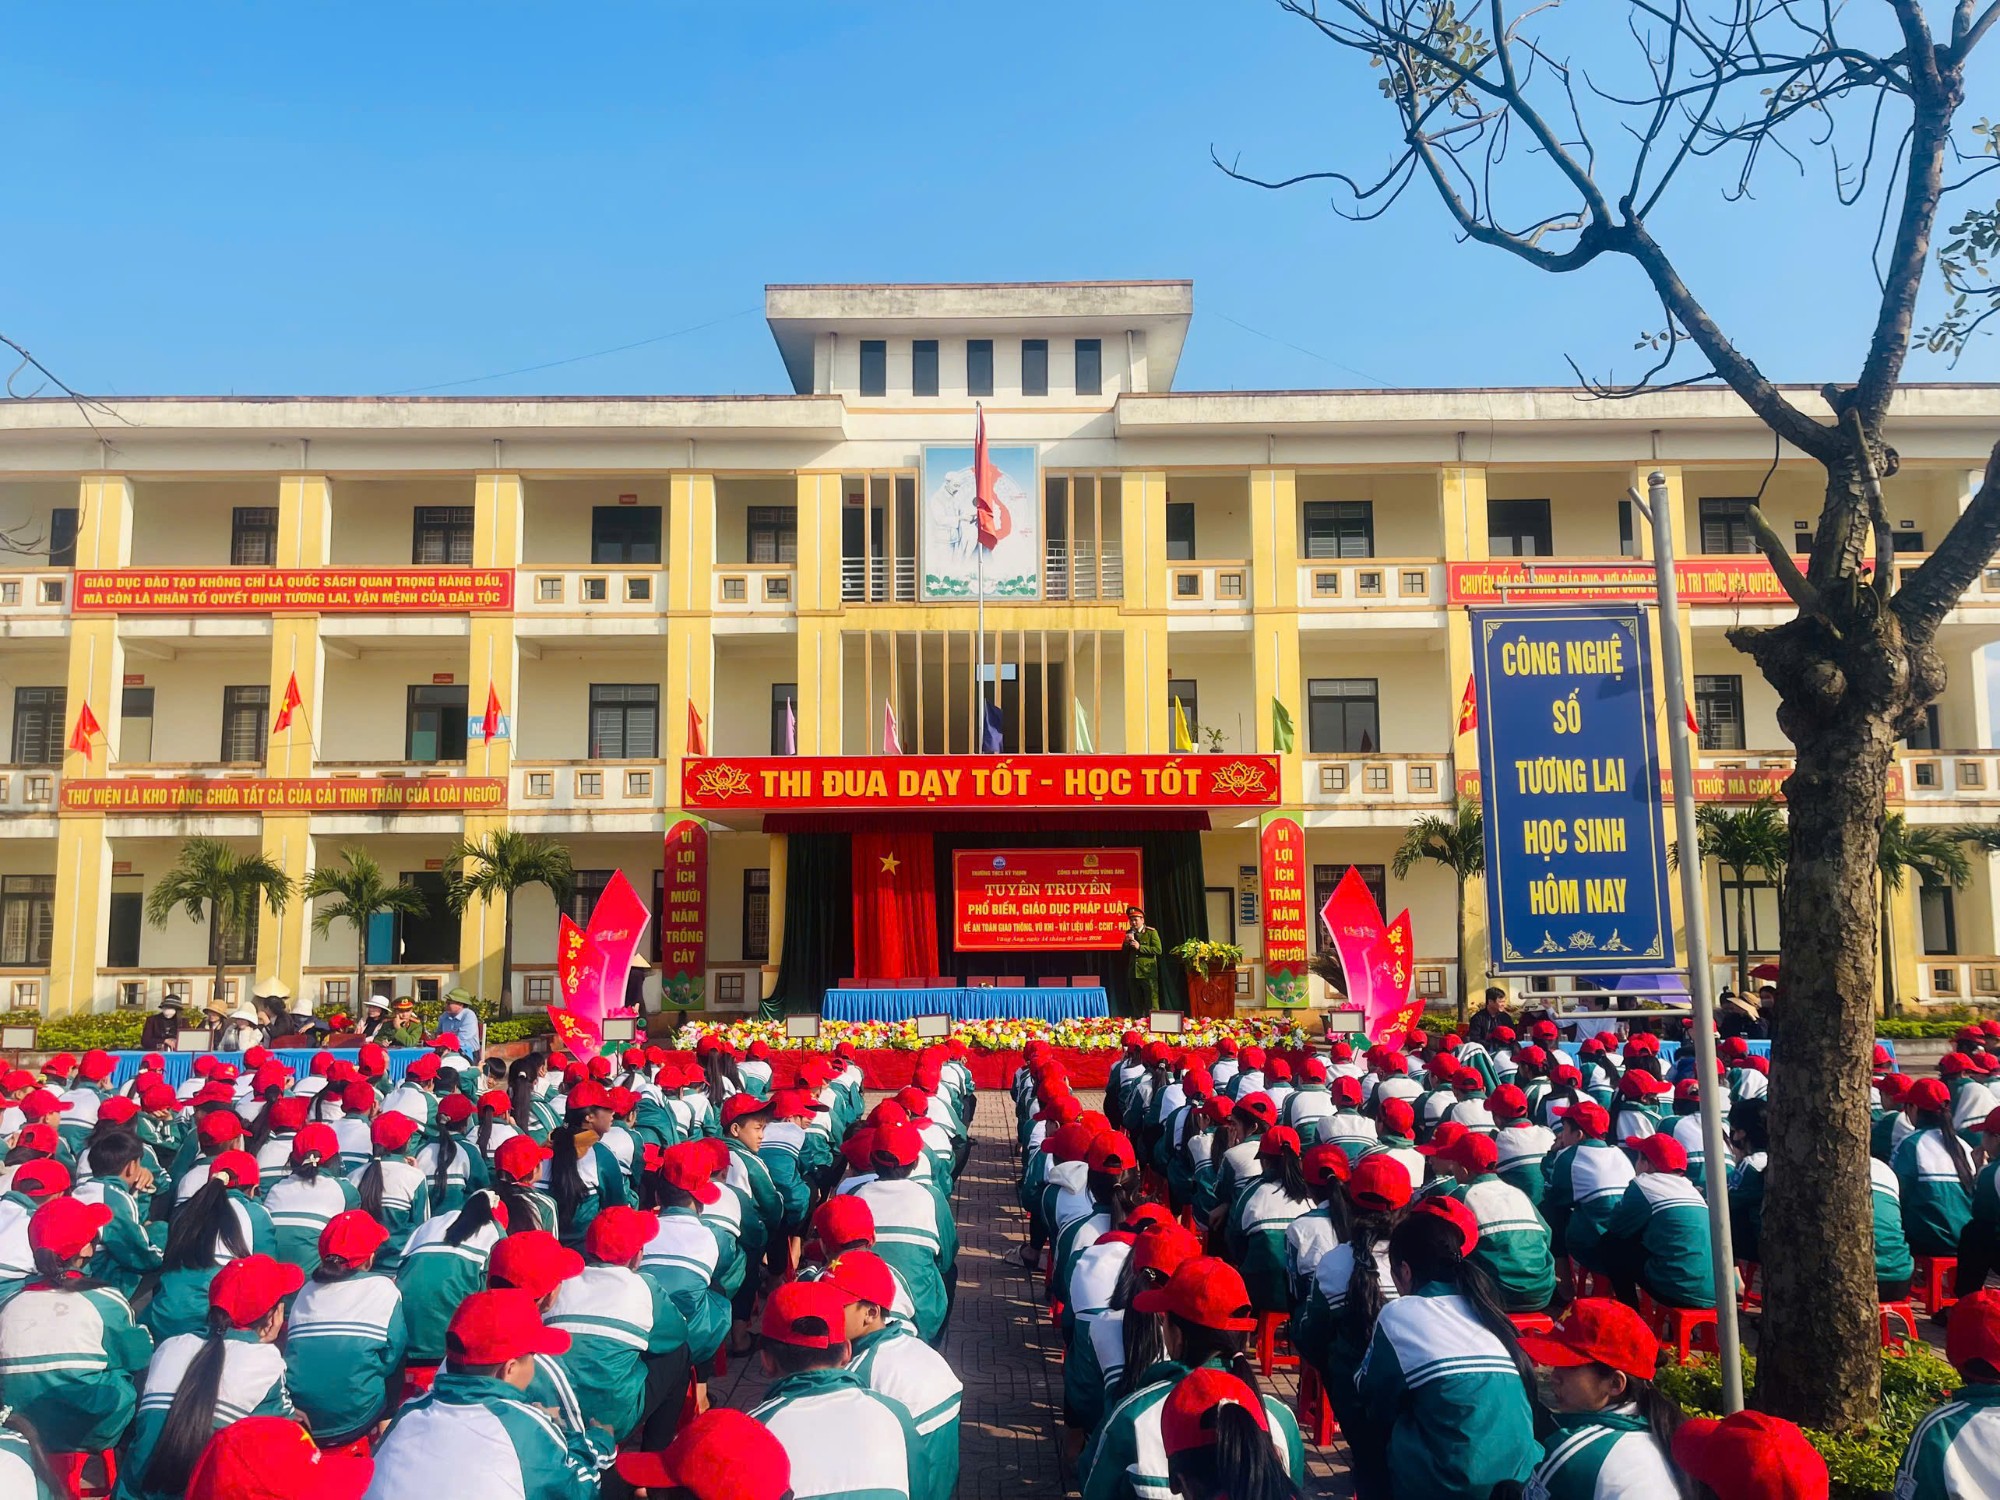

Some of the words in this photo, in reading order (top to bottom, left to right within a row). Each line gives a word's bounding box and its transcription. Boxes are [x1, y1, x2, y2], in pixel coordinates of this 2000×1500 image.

[84, 575, 113, 588] GIÁO
[116, 577, 141, 590] DỤC
[144, 575, 170, 588] ĐÀO
[173, 577, 196, 590] TẠO
[199, 575, 241, 588] KHÔNG
[244, 573, 266, 588] CHỈ
[268, 574, 284, 588] LÀ
[287, 573, 320, 588] QUỐC
[323, 575, 356, 588] SÁCH
[359, 576, 392, 588] QUAN
[396, 576, 435, 589] TRỌNG
[438, 574, 471, 588] HÀNG
[1687, 572, 1702, 593] TRI
[1703, 568, 1727, 593] THỨC
[83, 591, 103, 604] MÀ
[106, 592, 131, 605] CÒN
[135, 591, 150, 604] LÀ
[153, 592, 189, 604] NHÂN
[192, 589, 208, 604] TỐ
[211, 590, 248, 604] QUYẾT
[252, 593, 281, 606] ĐỊNH
[284, 591, 325, 604] TƯƠNG
[328, 592, 350, 604] LAI,
[354, 591, 379, 605] VẬN
[382, 591, 417, 605] MỆNH
[421, 589, 446, 603] CỦA
[449, 590, 475, 603] DÂN
[477, 590, 501, 605] TỘC
[1502, 635, 1561, 676] CÔNG
[1565, 633, 1624, 681] NGHỆ
[1552, 687, 1581, 734] SỐ
[760, 770, 811, 797] THI
[822, 770, 888, 797] ĐUA
[898, 769, 962, 802] DẠY
[971, 758, 1032, 796] TỐT
[1040, 778, 1053, 786] -
[1065, 768, 1132, 802] HỌC
[1141, 757, 1203, 796] TỐT
[1515, 756, 1588, 795] TƯƠNG
[1592, 758, 1627, 793] LAI
[1697, 774, 1726, 795] THỨC
[1728, 775, 1747, 795] MÀ
[67, 787, 92, 805] THƯ
[94, 785, 121, 808] VIỆN
[124, 785, 140, 804] LÀ
[143, 788, 168, 804] KHO
[171, 785, 203, 804] TÀNG
[207, 784, 239, 804] CHỨA
[243, 783, 265, 804] TẤT
[268, 782, 284, 804] CẢ
[288, 782, 312, 804] CỦA
[316, 782, 336, 804] CẢI
[340, 787, 368, 804] TINH
[371, 782, 402, 804] THẦN
[406, 781, 429, 803] CỦA
[433, 784, 460, 804] LOÀI
[464, 783, 501, 804] NGƯỜI
[681, 829, 692, 844] VÌ
[1277, 828, 1289, 842] VÌ
[1523, 819, 1568, 862] HỌC
[1573, 818, 1627, 853] SINH
[677, 850, 696, 866] LỢI
[1275, 849, 1293, 864] LỢI
[676, 869, 696, 883] ÍCH
[1274, 868, 1295, 882] ÍCH
[985, 880, 1040, 896] TUYÊN
[1044, 876, 1112, 896] TRUYỀN
[1269, 886, 1302, 901] TRĂM
[1529, 872, 1580, 915] HÔM
[1585, 878, 1627, 914] NAY
[670, 888, 701, 903] MƯỜI
[968, 899, 990, 915] PHỔ
[991, 900, 1019, 916] BIẾN,
[1022, 901, 1047, 915] GIÁO
[1049, 902, 1070, 916] DỤC
[1073, 900, 1101, 914] PHÁP
[1103, 900, 1129, 916] LUẬT
[1272, 907, 1300, 921] NĂM
[671, 910, 699, 923] NĂM
[972, 923, 980, 932] AN
[998, 922, 1012, 932] GIAO
[1098, 921, 1113, 931] CCHT
[1268, 925, 1305, 941] TRỒNG
[666, 927, 704, 943] TRỒNG
[672, 948, 696, 963] CÂY
[1269, 946, 1305, 961] NGƯỜI
